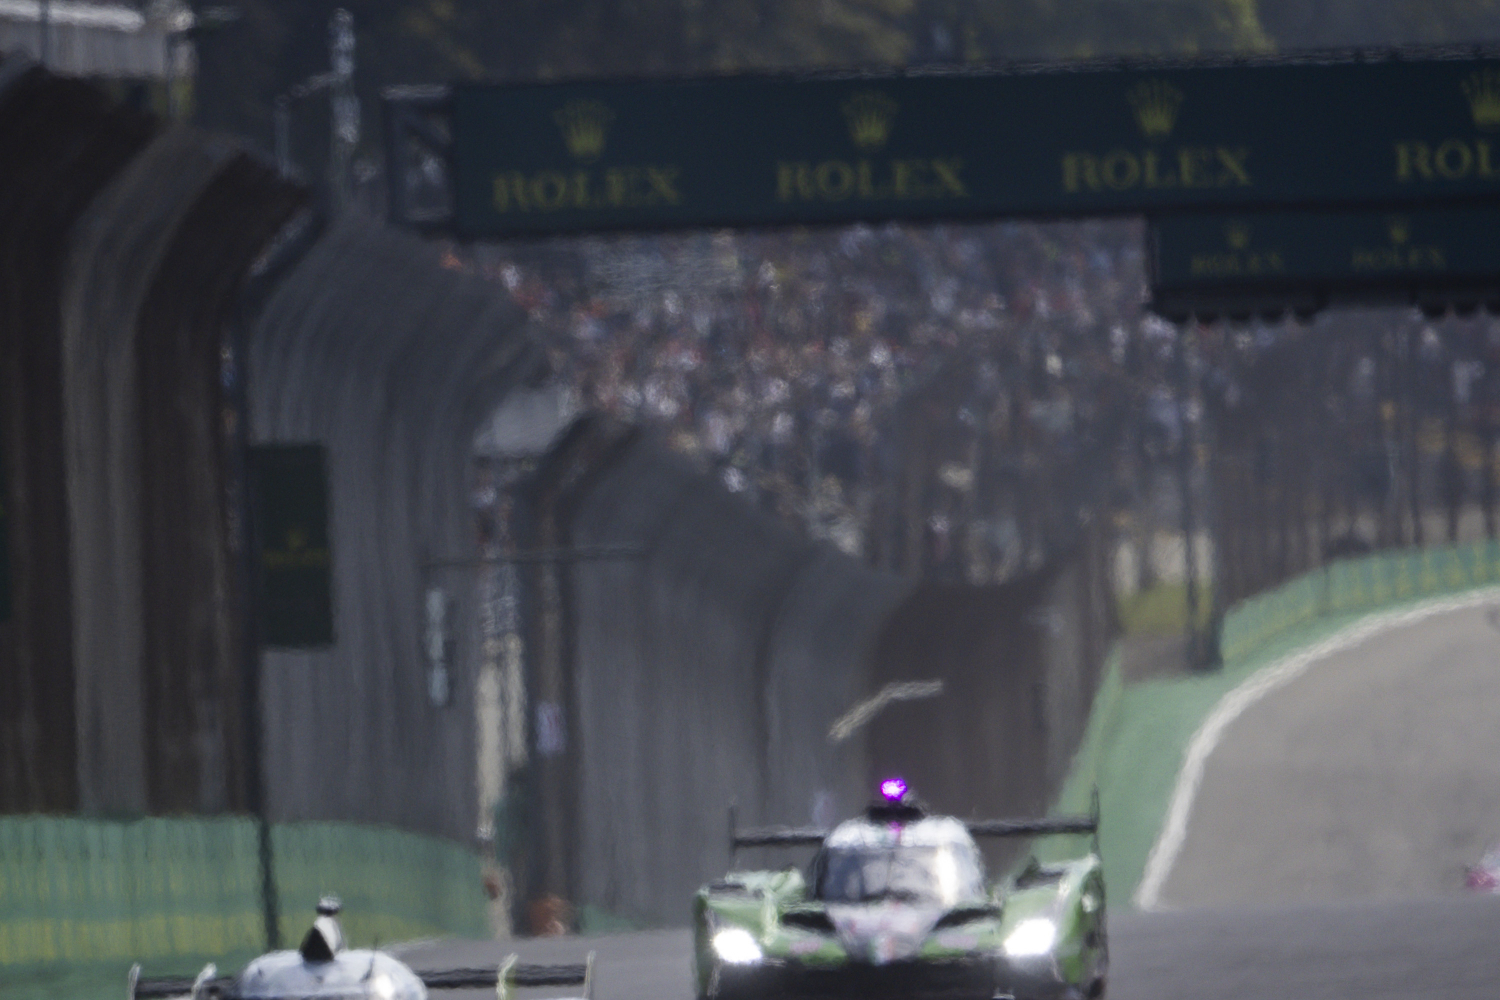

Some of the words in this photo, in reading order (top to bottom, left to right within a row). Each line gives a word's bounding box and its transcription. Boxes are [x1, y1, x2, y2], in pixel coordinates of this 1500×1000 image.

[493, 168, 681, 212] ROLEX
[777, 159, 969, 201] ROLEX
[1062, 147, 1252, 192] ROLEX
